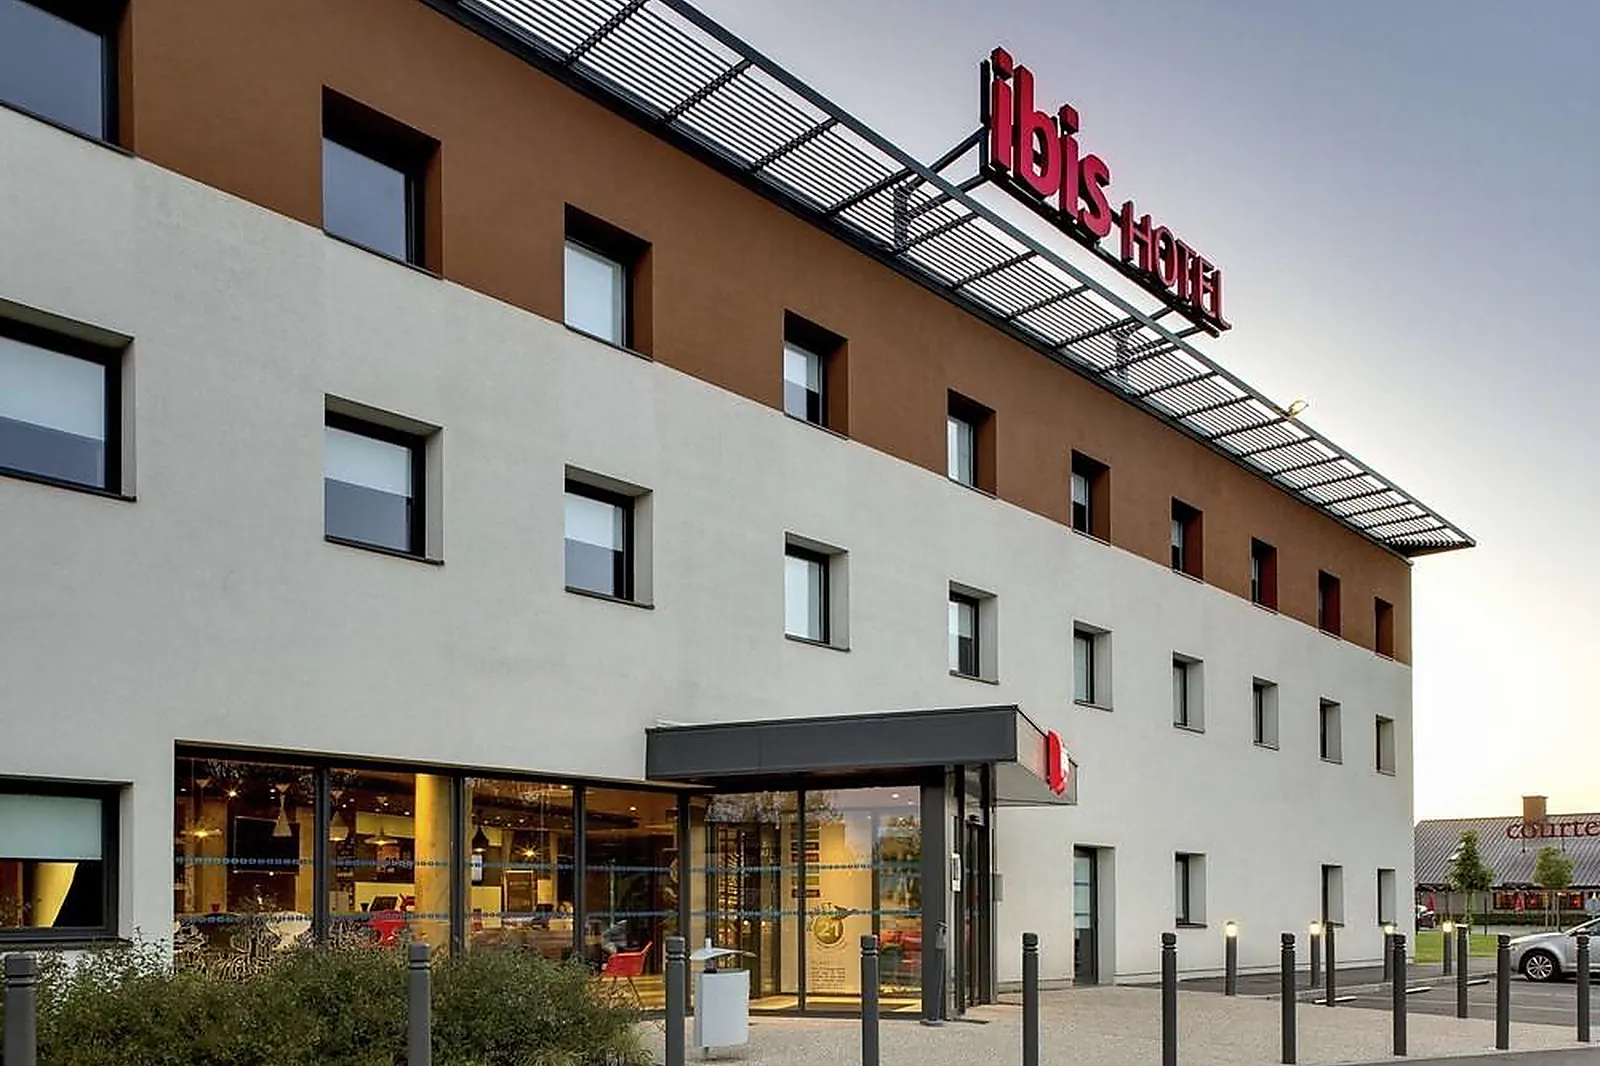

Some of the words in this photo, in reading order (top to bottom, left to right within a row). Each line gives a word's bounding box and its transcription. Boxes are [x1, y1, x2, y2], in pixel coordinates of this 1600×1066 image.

[991, 46, 1112, 239] ibis
[1120, 200, 1232, 332] HOTEL
[1506, 821, 1600, 839] courte
